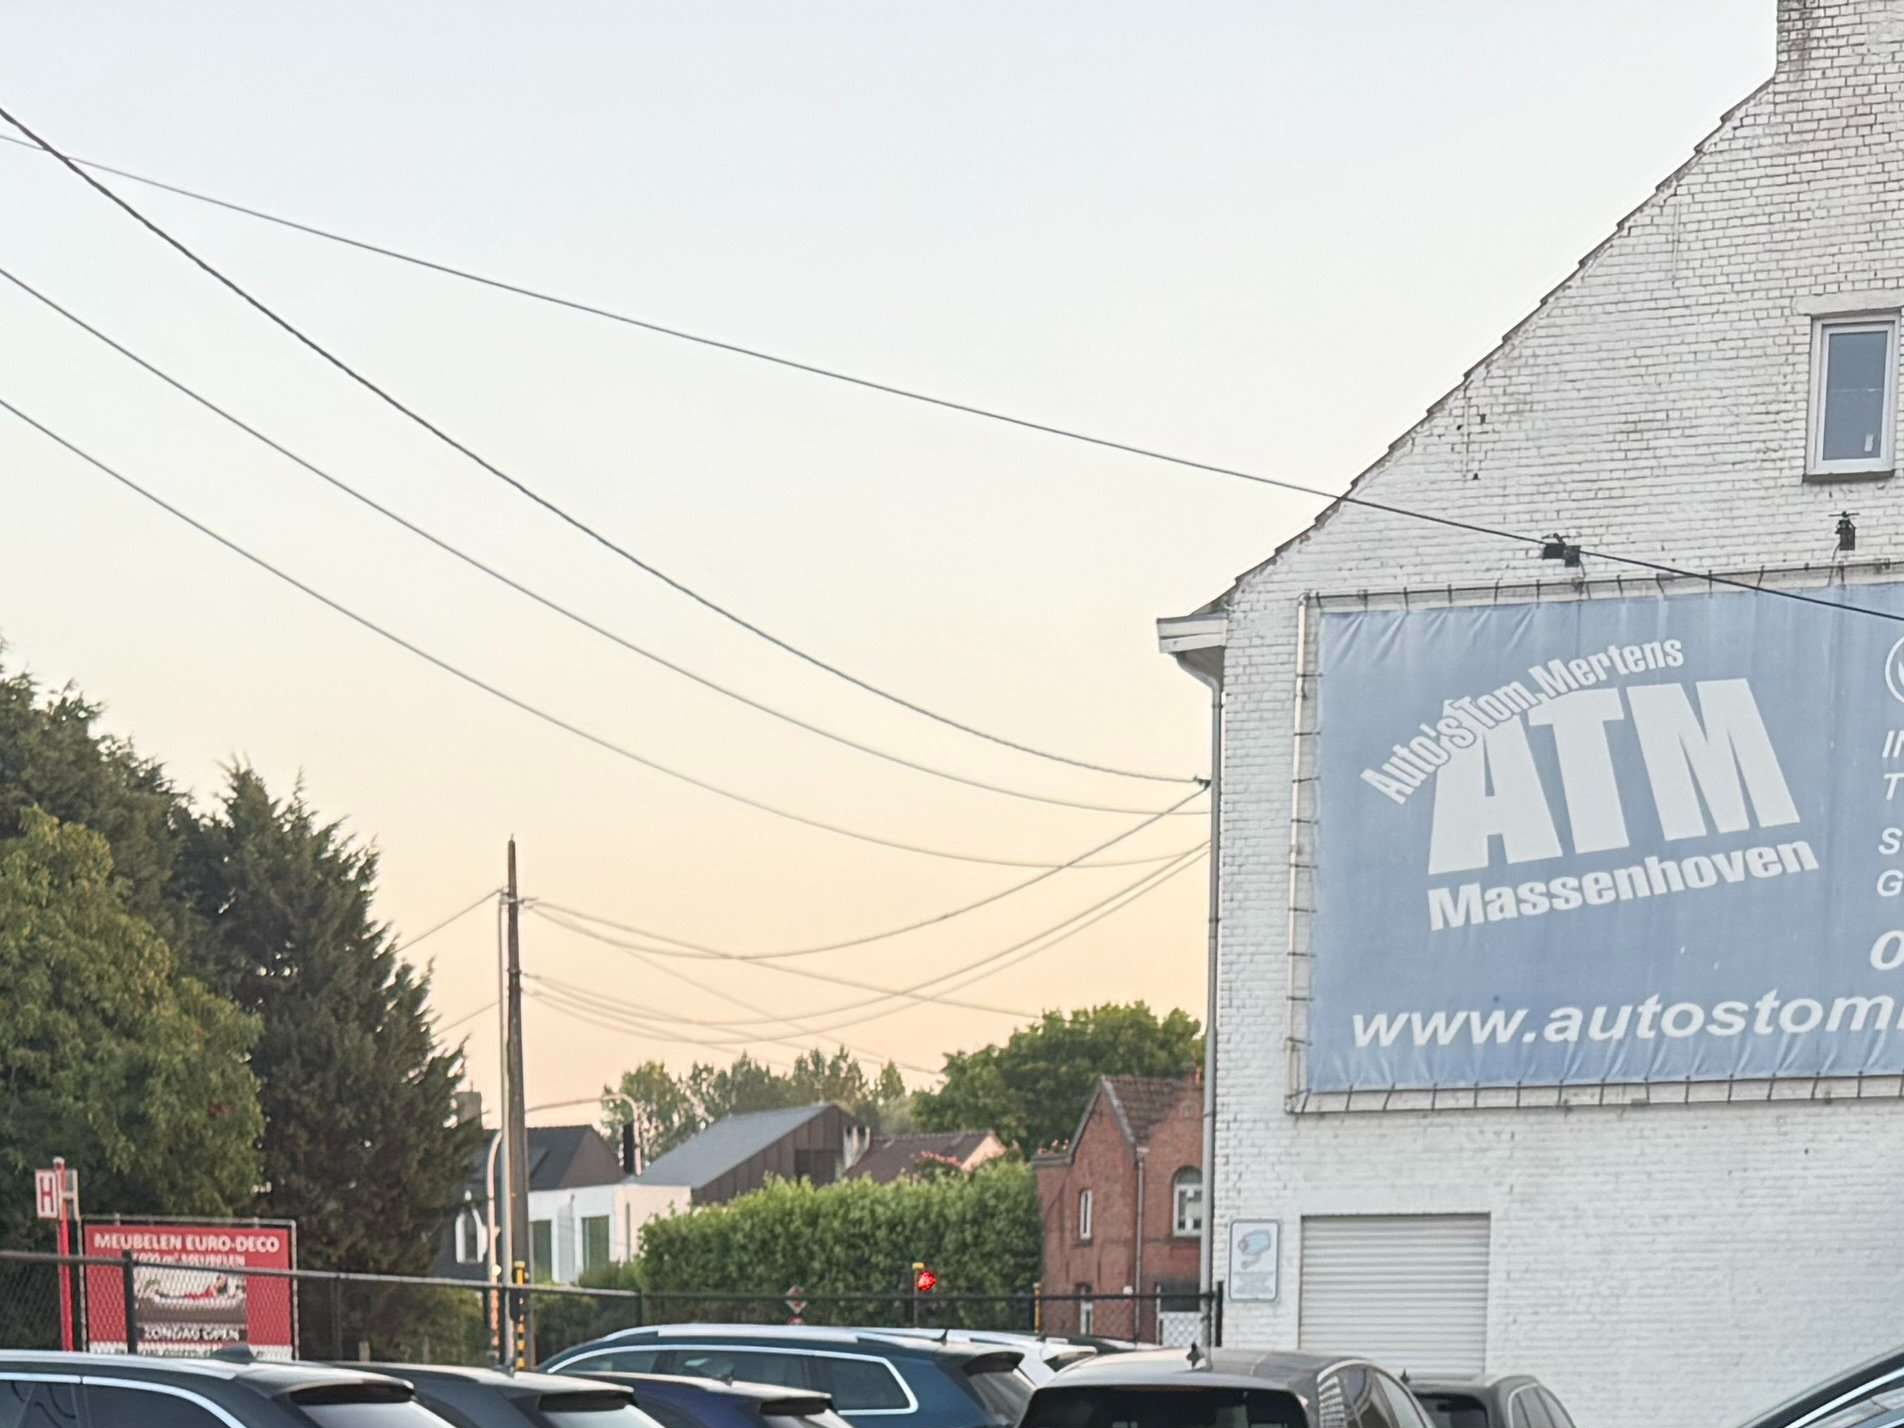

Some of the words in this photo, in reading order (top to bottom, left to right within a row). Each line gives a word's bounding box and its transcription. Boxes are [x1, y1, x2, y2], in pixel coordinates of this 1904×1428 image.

[1360, 716, 1477, 805] Auto's
[1450, 681, 1539, 730] Tom
[1528, 638, 1684, 700] Mertens
[1427, 677, 1800, 876] ATM
[1427, 839, 1819, 932] Massenhoven
[94, 1233, 182, 1250] MEUBELEN
[185, 1234, 280, 1252] EURO-DECO
